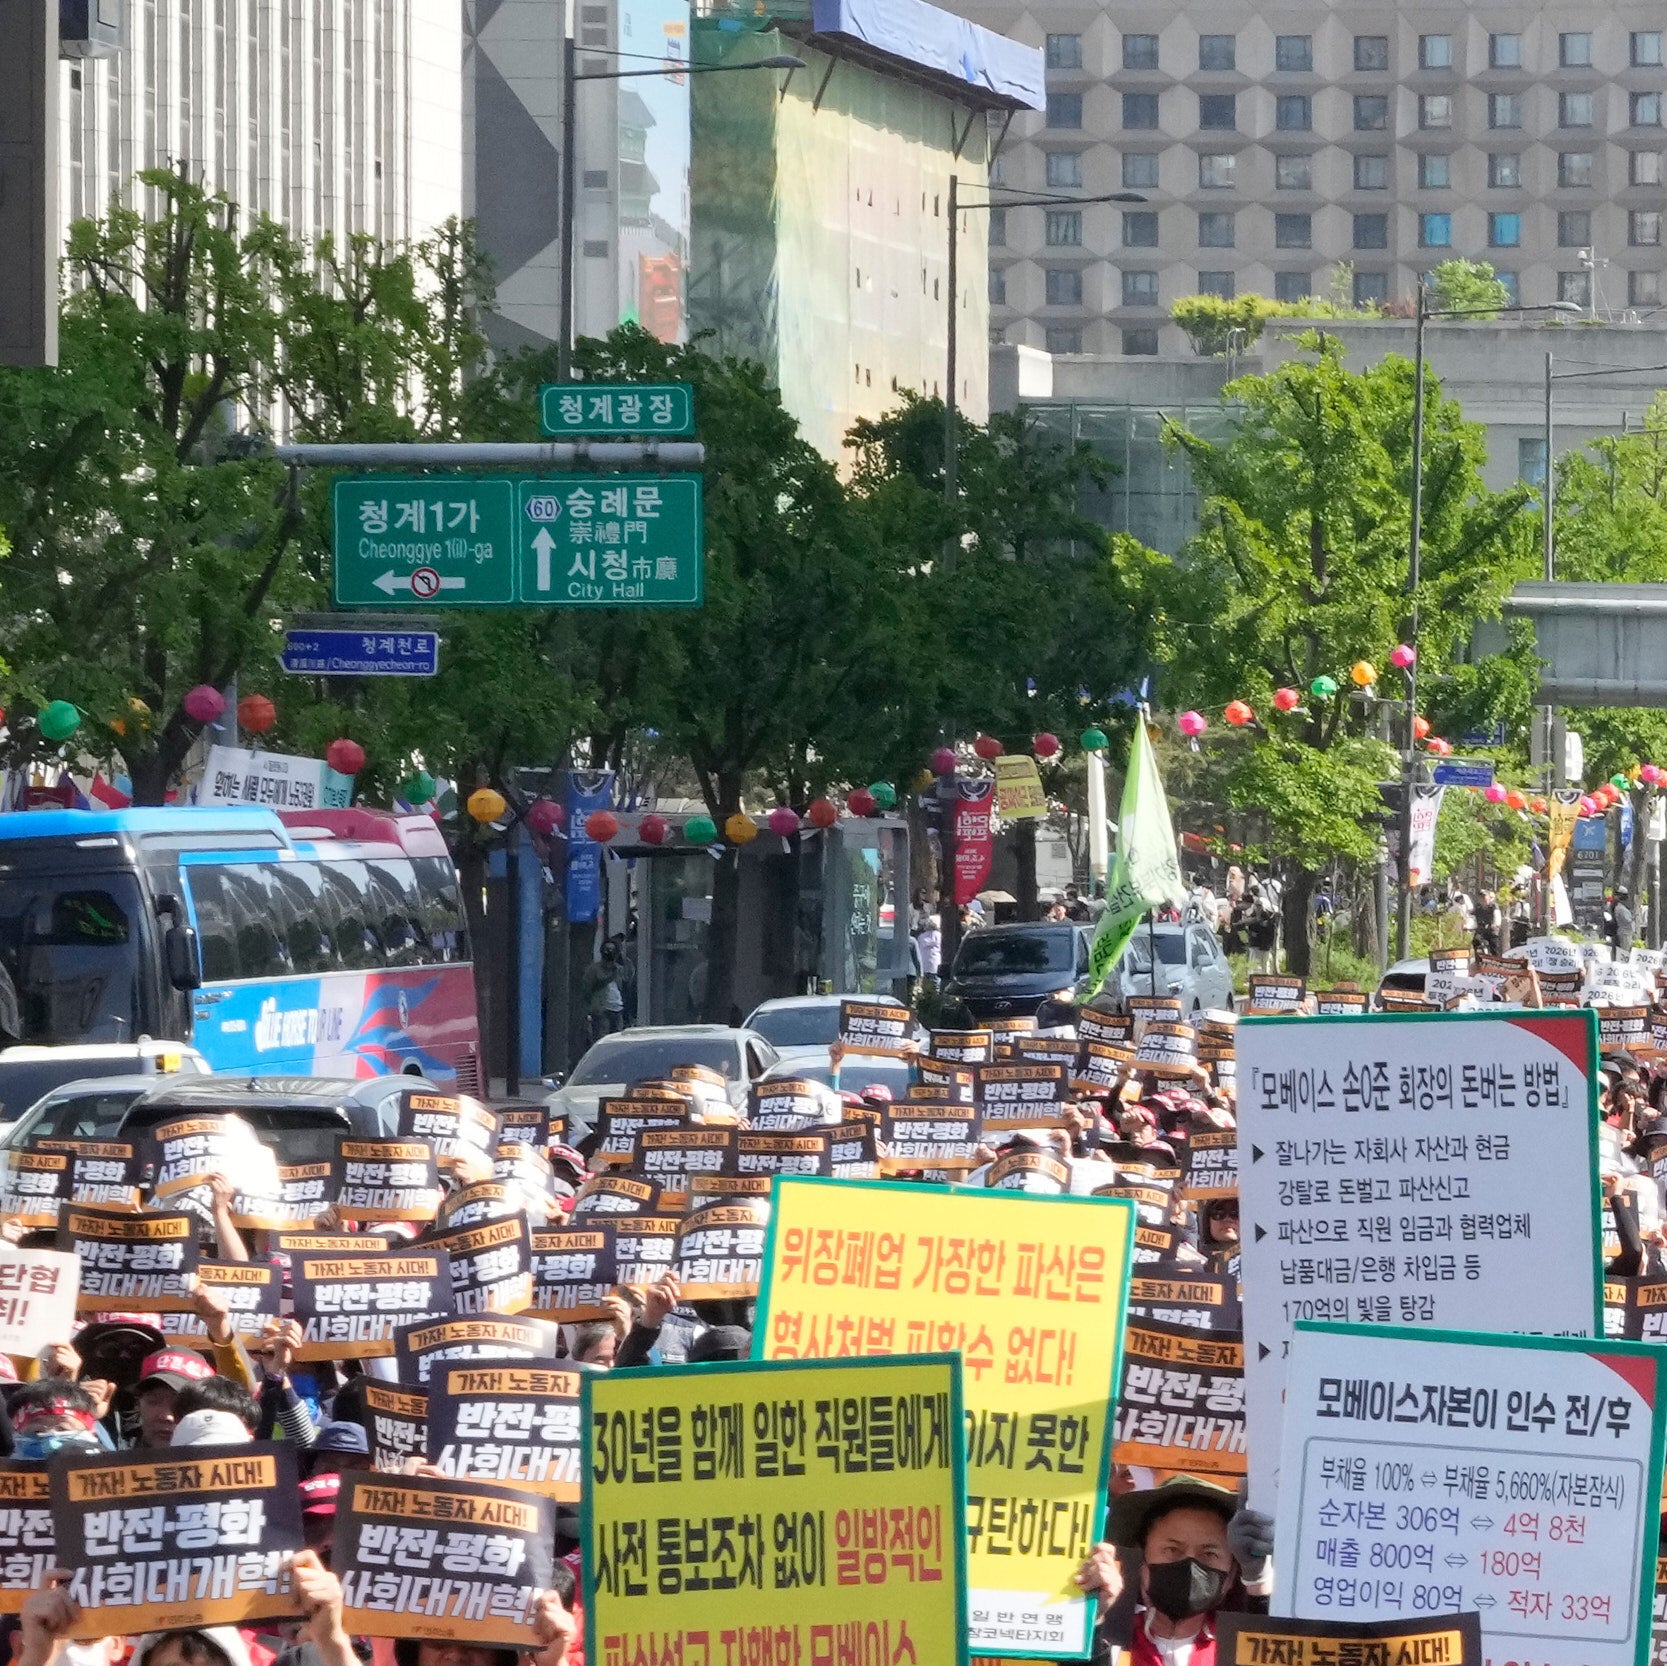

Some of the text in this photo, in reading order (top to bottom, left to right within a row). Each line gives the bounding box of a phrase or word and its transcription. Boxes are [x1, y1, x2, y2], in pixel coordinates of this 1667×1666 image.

[559, 395, 673, 425] 청계광장
[359, 499, 480, 534] 청계1가
[534, 500, 555, 518] 60
[566, 487, 663, 518] 숭례문
[569, 521, 647, 544] 崇禮門
[359, 538, 441, 563] Cheonggye
[568, 583, 643, 599] City Hall
[1399, 1065, 1453, 1110] 회장의
[1461, 1064, 1516, 1108] 돈버는
[1276, 1135, 1510, 1166] 잘나가는 자회사 자산과 현금
[1278, 1177, 1470, 1206] 강탈로 돈벌고 파산신고
[1278, 1212, 1531, 1245] 파산으로 직원 임금과 협력업체
[782, 1227, 1105, 1303] 위장폐업 가장한 파산은
[1317, 1377, 1632, 1439] 모베이스자본이 인수 전/후
[593, 1392, 948, 1483] 30년을 함께 일한 직원들에게
[131, 1467, 203, 1492] 노동자
[210, 1461, 264, 1487] 시대!
[1321, 1457, 1366, 1491] 부채율
[1375, 1461, 1415, 1491] 100%
[1443, 1464, 1490, 1499] 부채율
[595, 1505, 943, 1596] 사전 통보조차 없이 일방적인
[1316, 1538, 1542, 1579] 매출 800억 180억
[1314, 1577, 1612, 1624] 영업이익 80억 적자 33억
